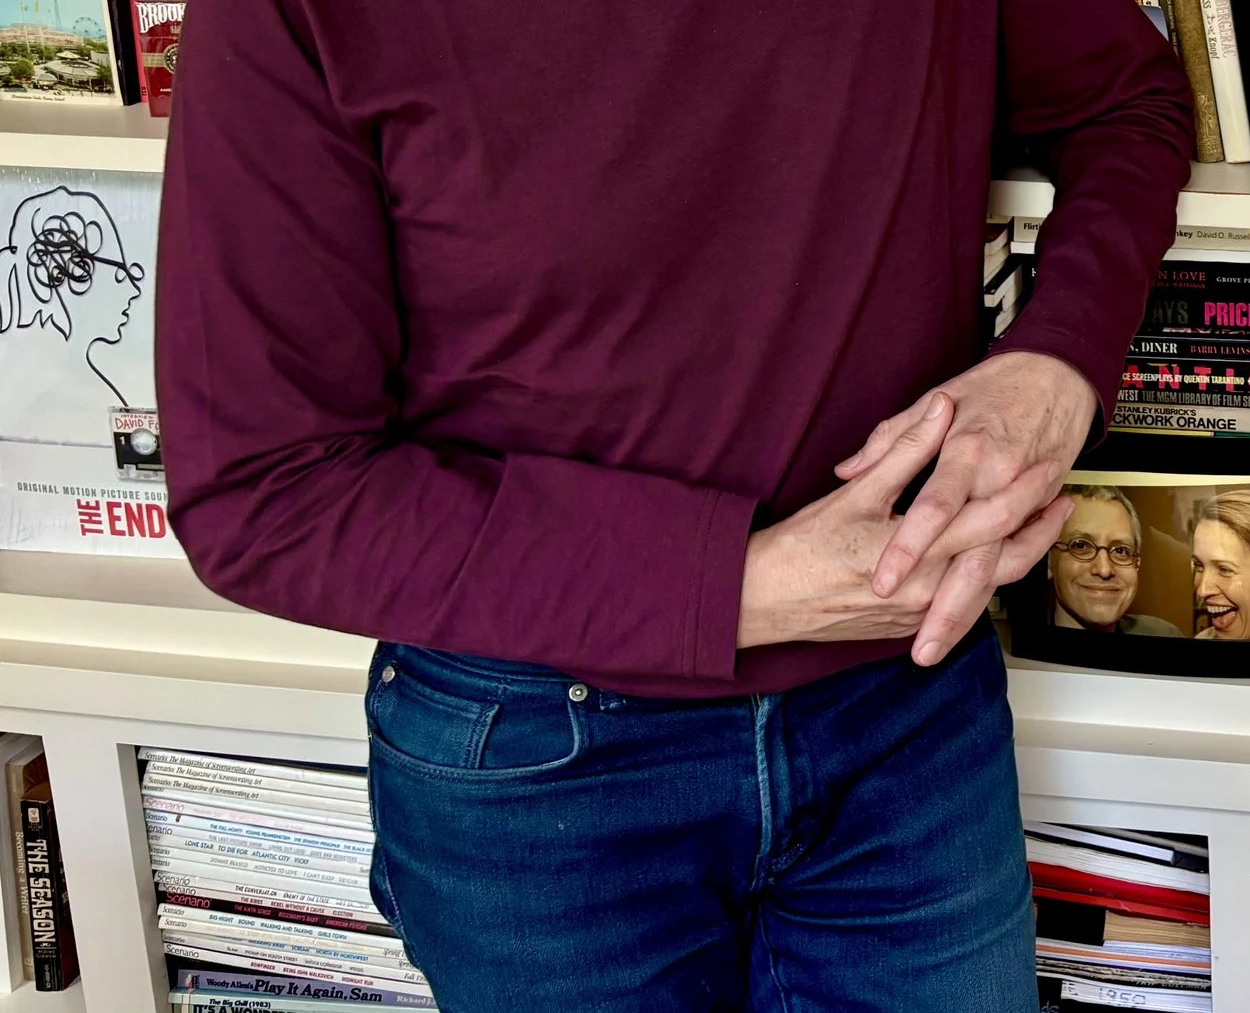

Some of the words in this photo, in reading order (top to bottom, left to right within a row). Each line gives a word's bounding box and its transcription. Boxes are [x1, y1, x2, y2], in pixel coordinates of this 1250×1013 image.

[1117, 406, 1152, 414] STANLEY
[1154, 407, 1196, 416] KUBRICK'S
[1176, 416, 1237, 430] ORANGE
[115, 418, 144, 430] DAVID
[17, 482, 59, 494] ORIGINAL
[63, 486, 97, 497] MOTION
[101, 489, 140, 500] PICTURE
[76, 499, 104, 536] THE
[106, 501, 166, 539] END
[26, 839, 50, 875] THE
[30, 877, 56, 945] SEASON
[252, 979, 284, 996] Play
[287, 981, 298, 992] It
[300, 983, 348, 1000] Again,
[349, 987, 383, 1003] Sam
